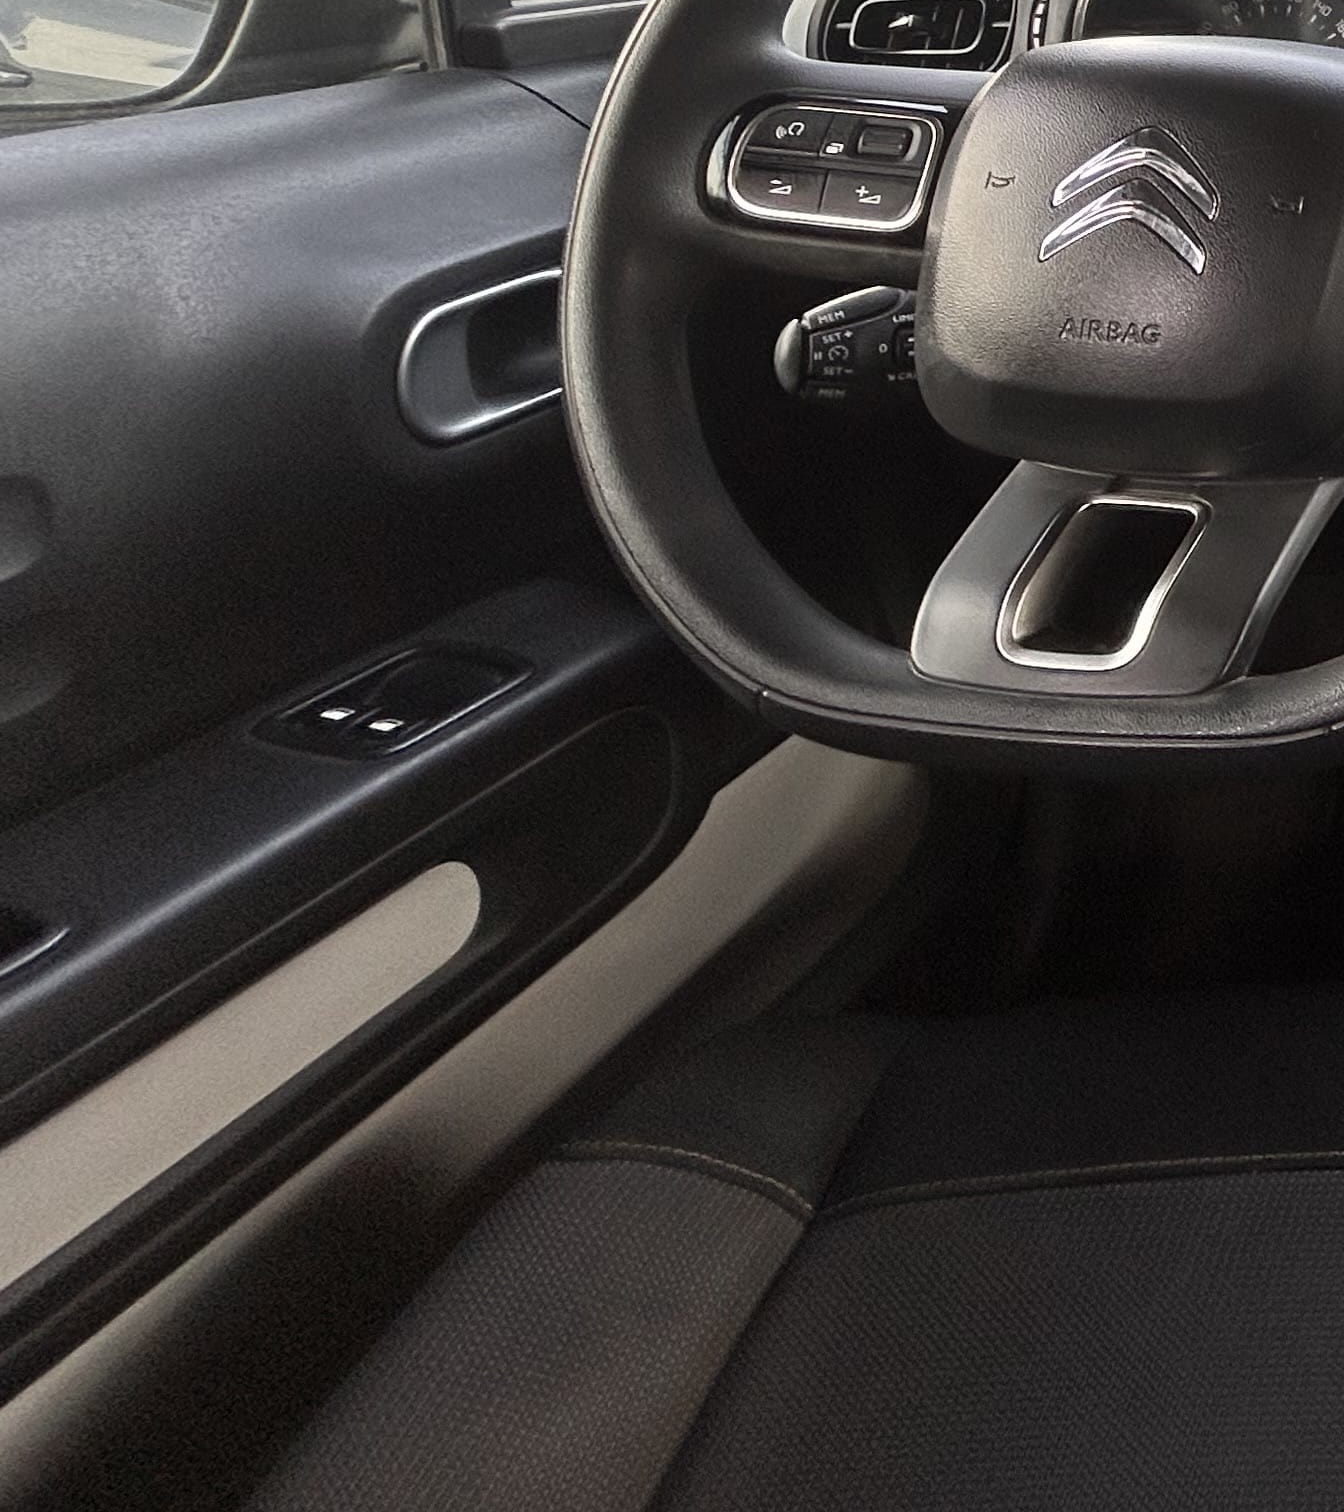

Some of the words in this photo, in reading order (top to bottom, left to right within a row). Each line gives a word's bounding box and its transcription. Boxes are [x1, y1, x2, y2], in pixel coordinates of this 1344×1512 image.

[1312, 0, 1333, 17] 140
[818, 310, 846, 325] MEM
[1058, 317, 1162, 345] AIRBAG
